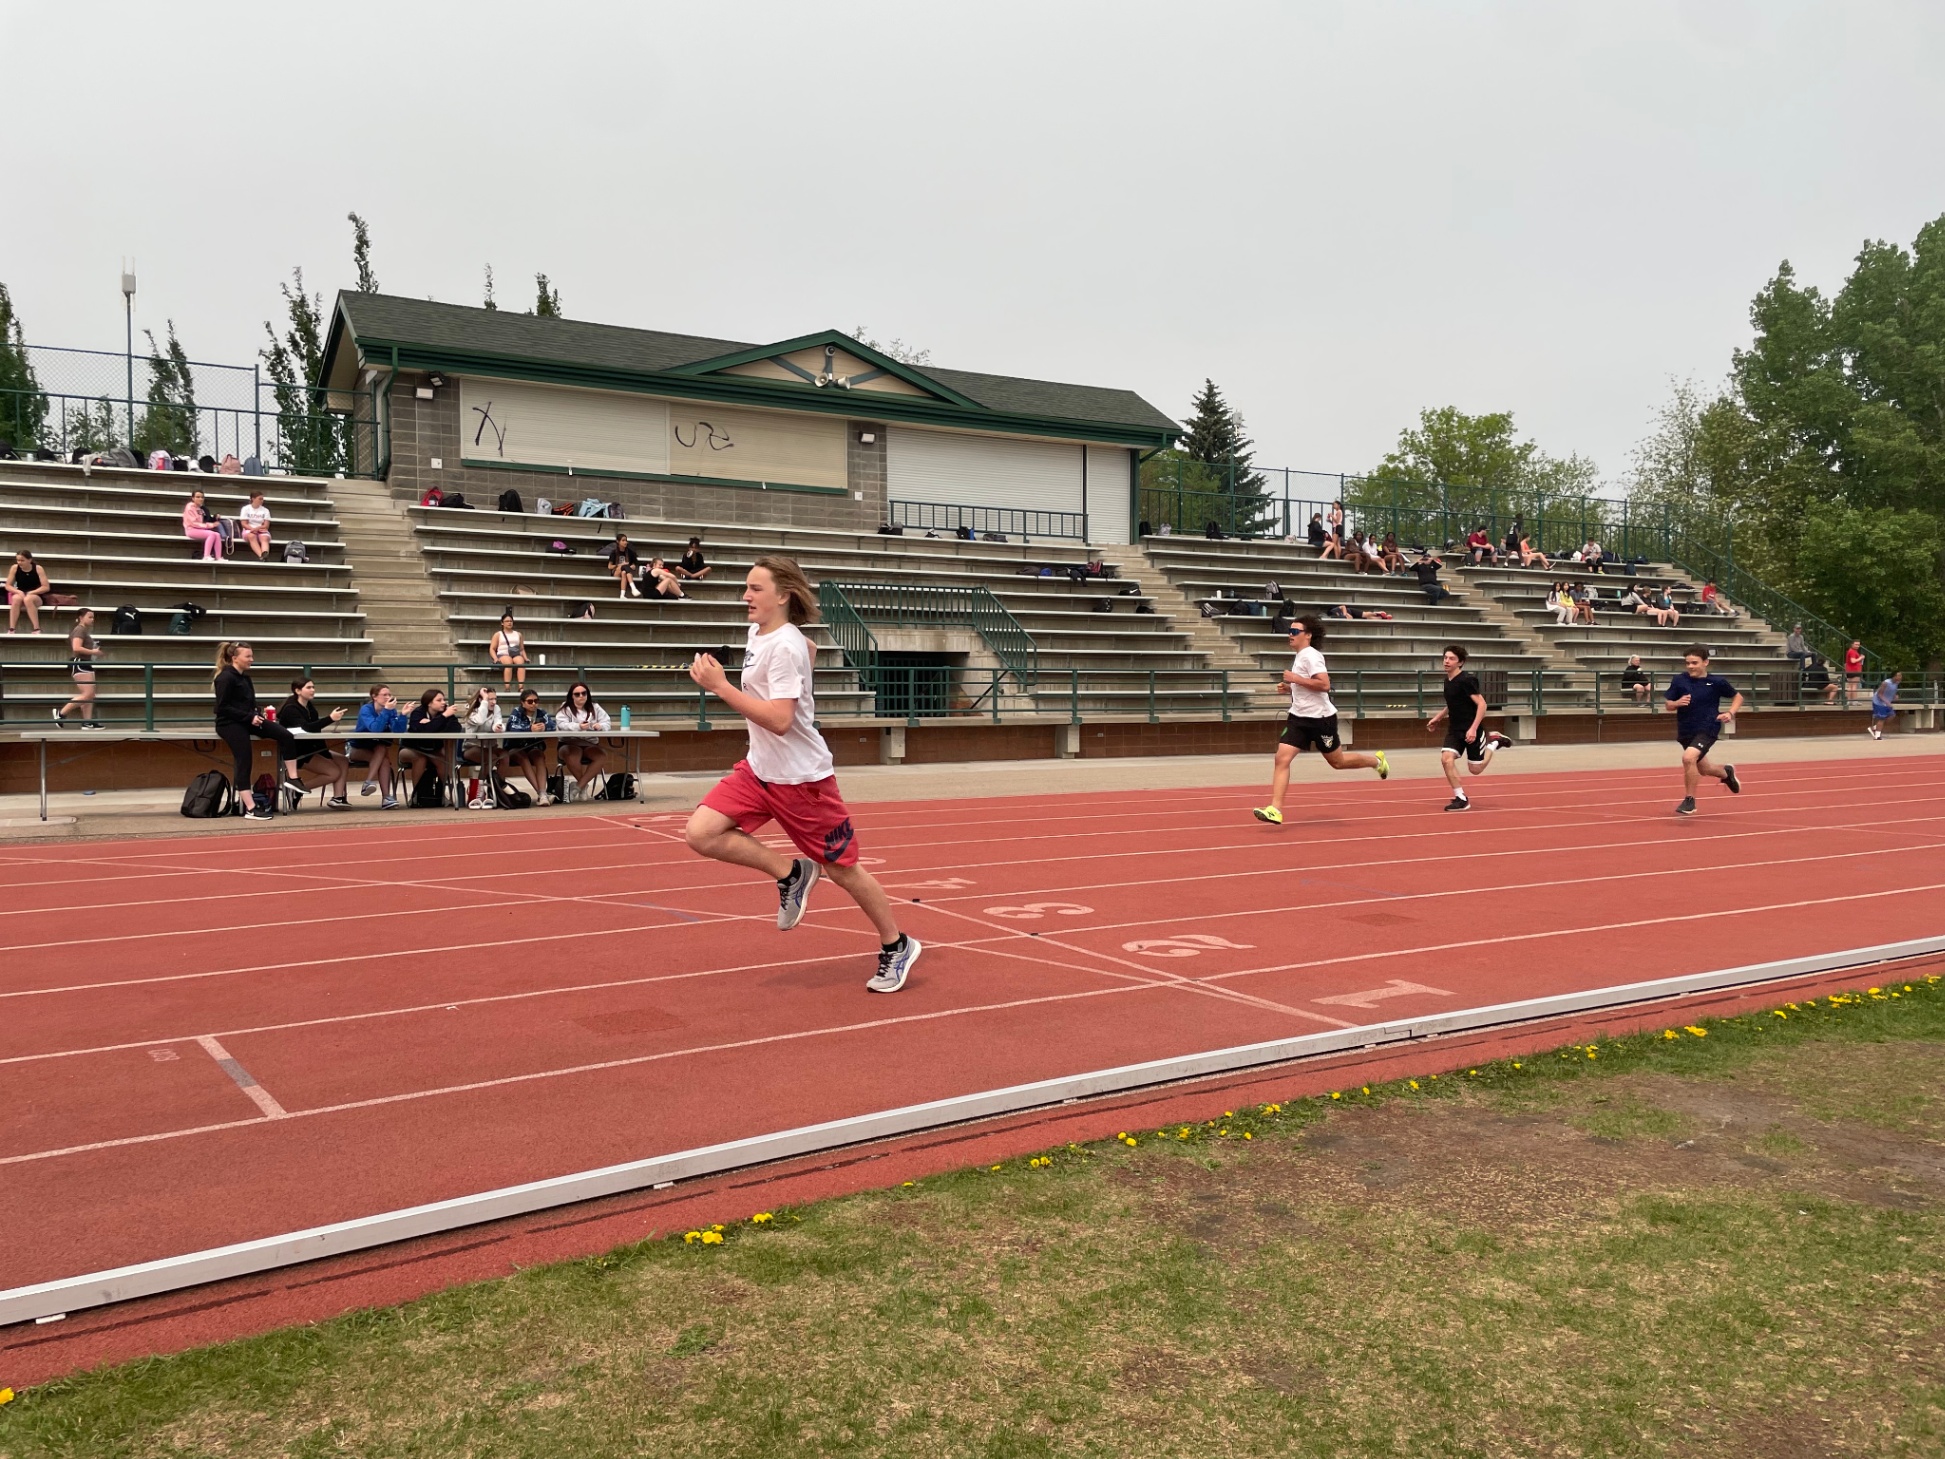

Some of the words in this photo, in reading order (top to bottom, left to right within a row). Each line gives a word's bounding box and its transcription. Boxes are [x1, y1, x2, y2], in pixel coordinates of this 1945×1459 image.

[983, 902, 1095, 919] 3
[1121, 934, 1257, 957] 2
[1310, 979, 1457, 1009] 1
